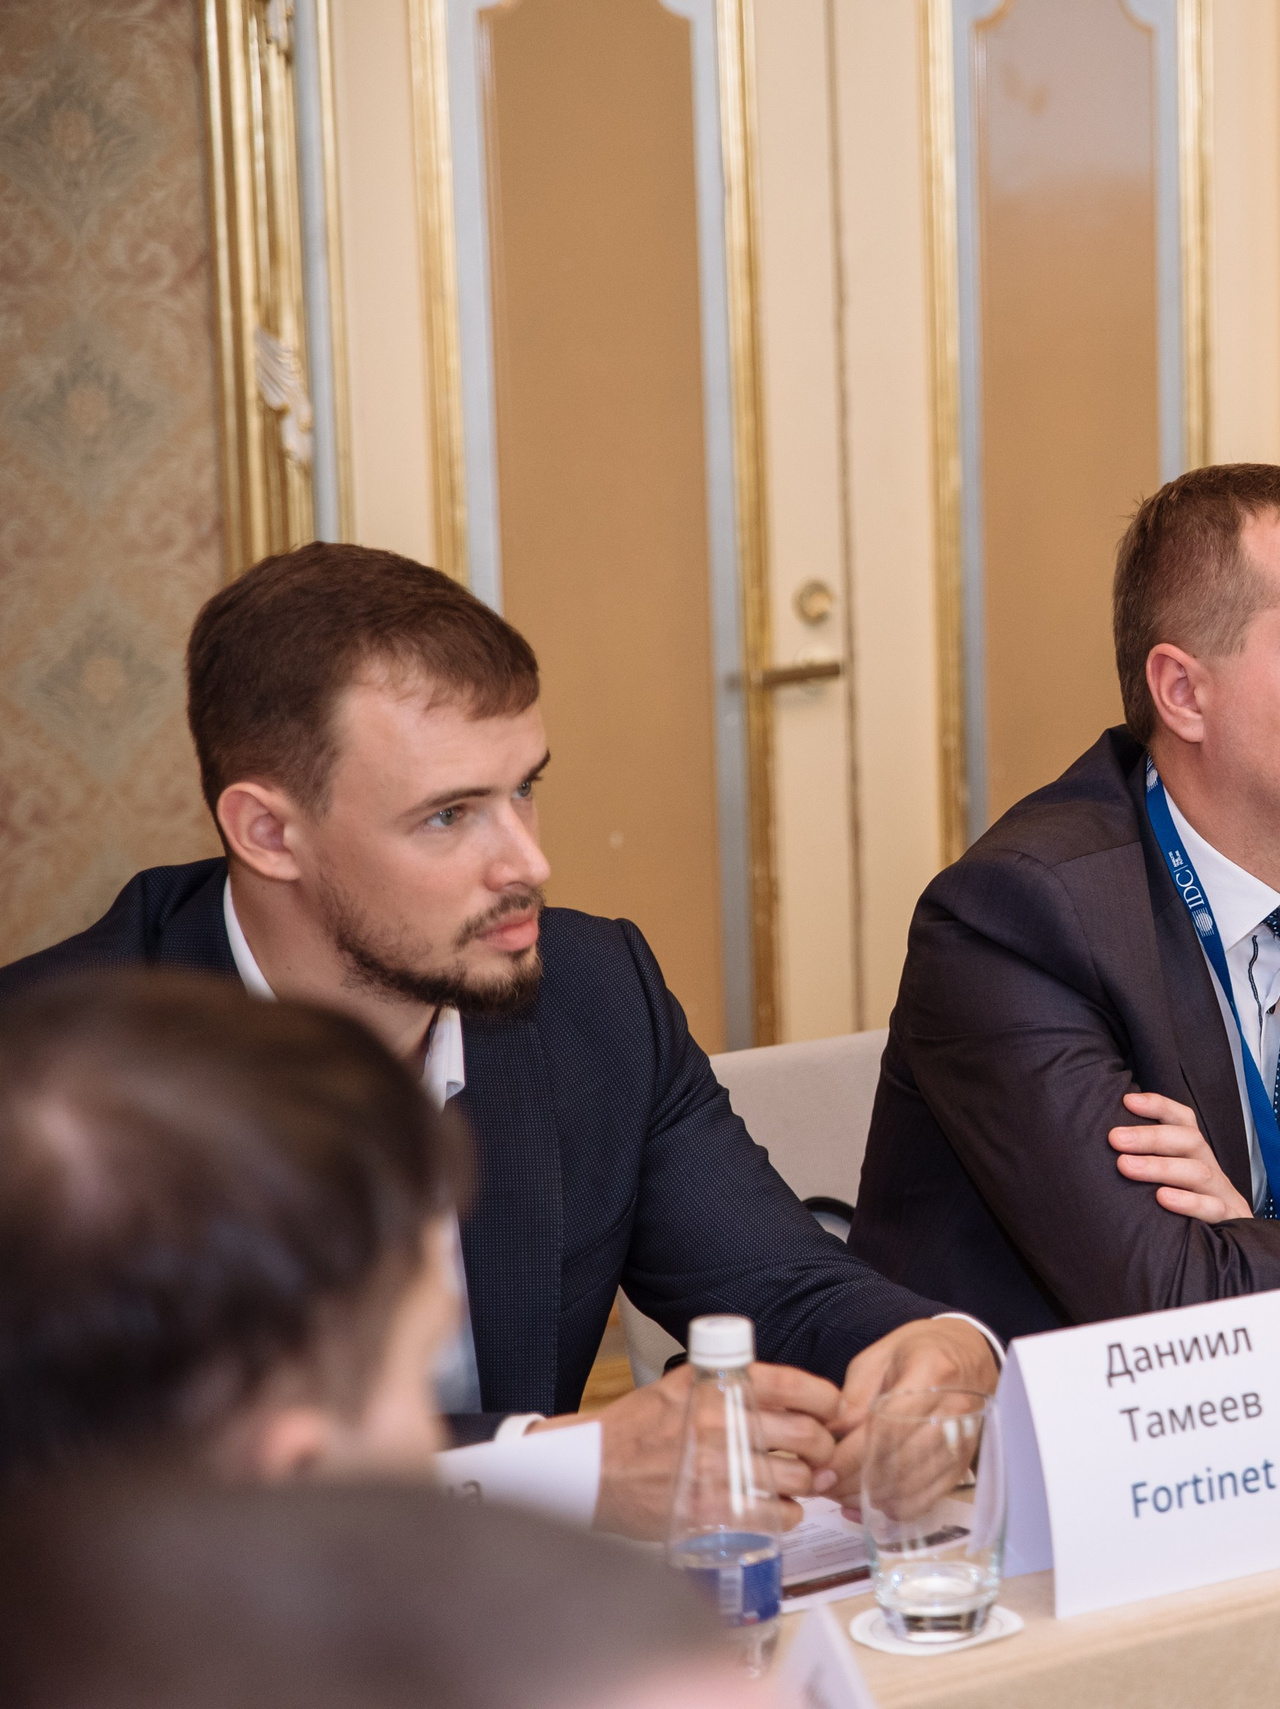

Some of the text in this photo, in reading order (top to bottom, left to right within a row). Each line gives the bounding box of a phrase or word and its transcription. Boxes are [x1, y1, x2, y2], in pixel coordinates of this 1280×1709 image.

[1176, 869, 1204, 909] IDC
[1106, 1327, 1253, 1387] Даниил
[1120, 1392, 1263, 1442] Тамеев
[1131, 1459, 1276, 1518] Fortinet
